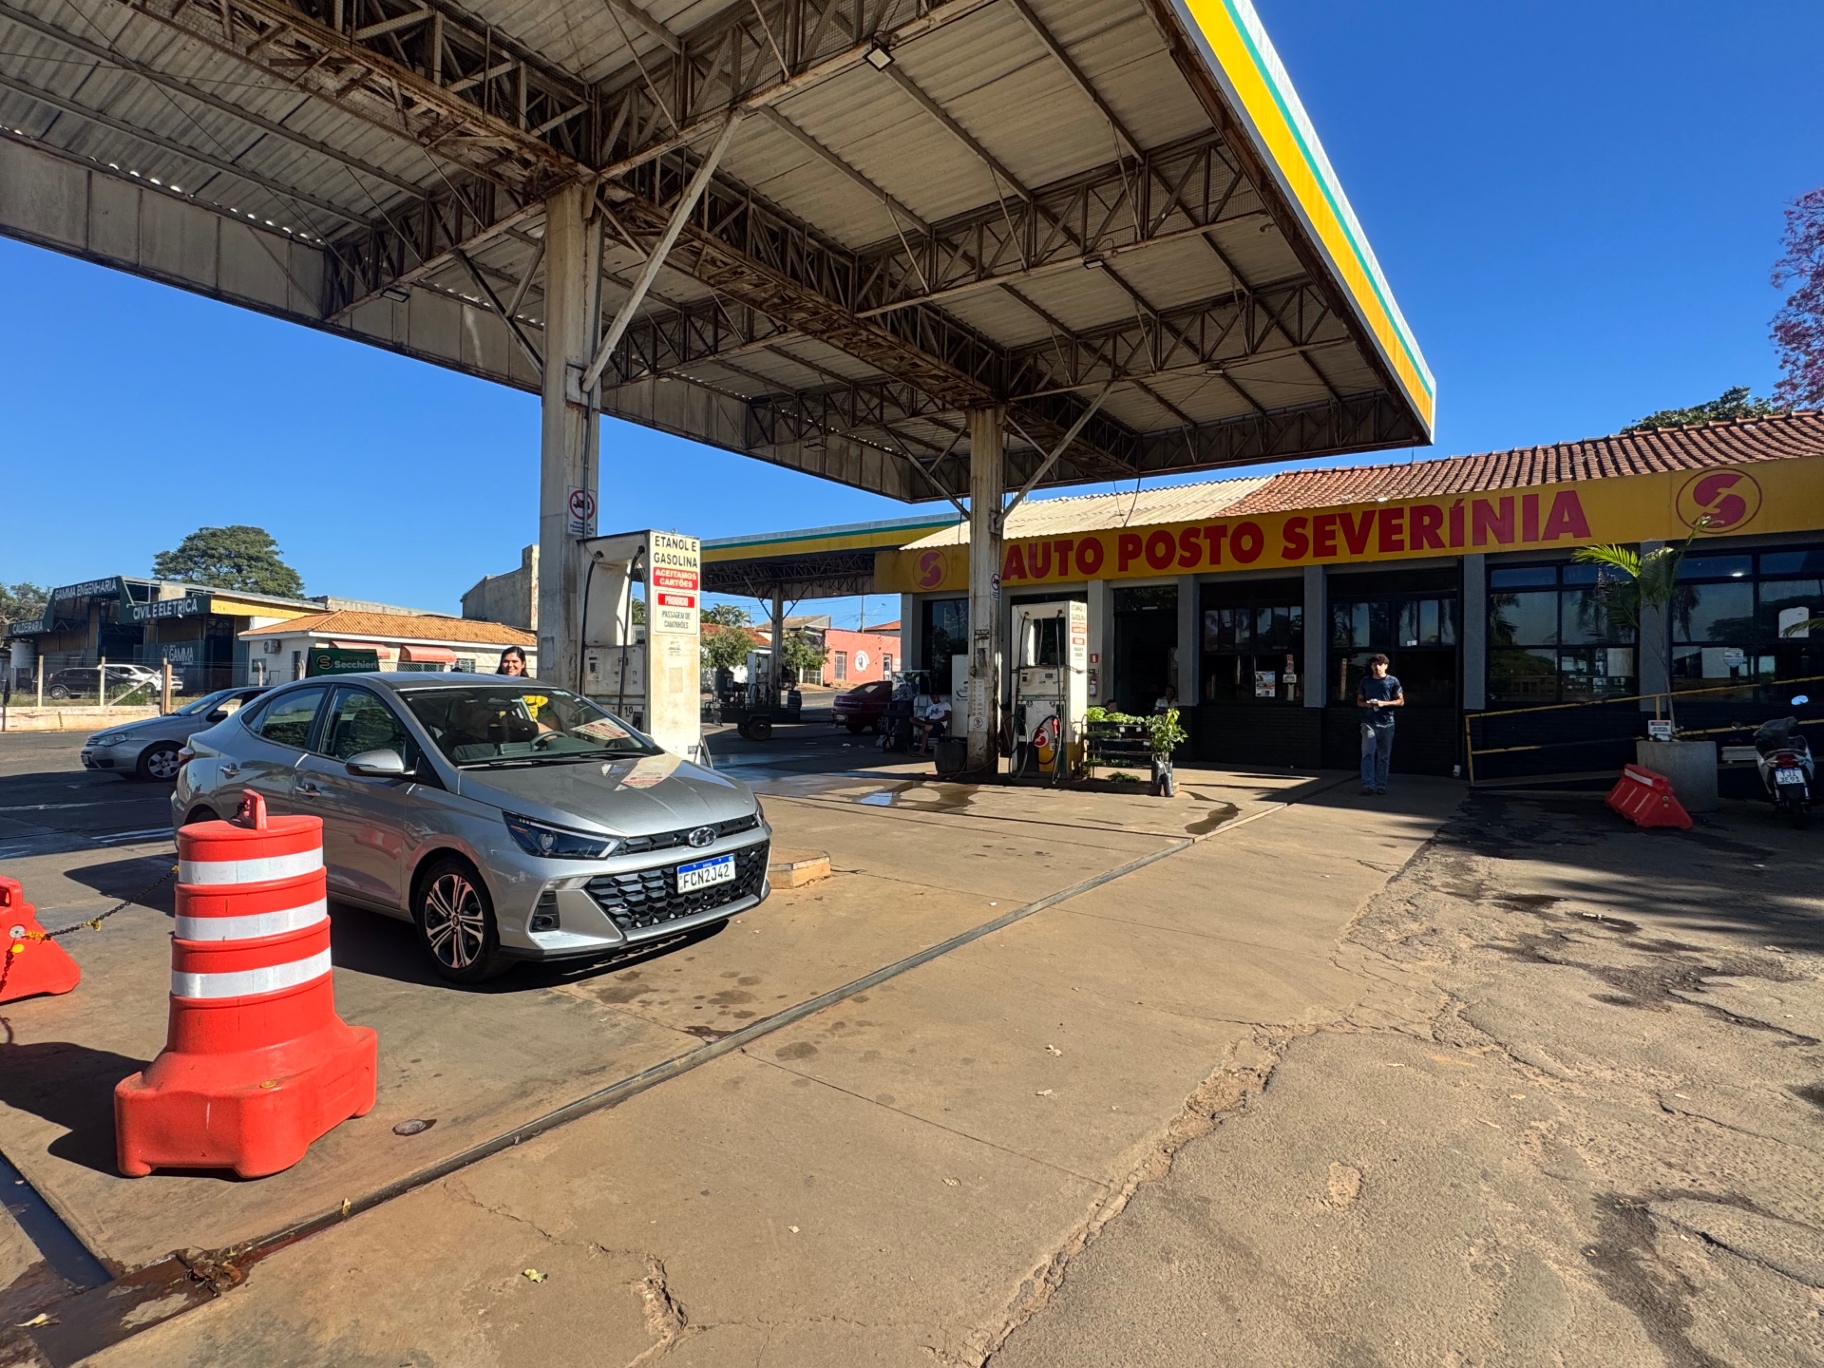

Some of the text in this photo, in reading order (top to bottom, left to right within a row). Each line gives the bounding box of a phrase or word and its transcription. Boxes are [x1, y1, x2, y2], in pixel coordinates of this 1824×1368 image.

[655, 535, 697, 552] ETANOL E
[1002, 490, 1592, 582] AUTO POSTO SEVERÍNIA
[654, 552, 698, 569] GASOLINA
[655, 568, 697, 581] ACEITAMOS
[76, 579, 117, 597] ENGENHARIA
[659, 577, 693, 589] CARTÕES
[133, 605, 151, 620] CIVIL
[152, 604, 158, 618] E
[662, 610, 691, 620] PASSAGEM DE
[169, 646, 194, 662] GAMMA
[333, 660, 377, 669] Secchieri
[624, 706, 634, 715] 10
[683, 864, 730, 889] FCN2J42
